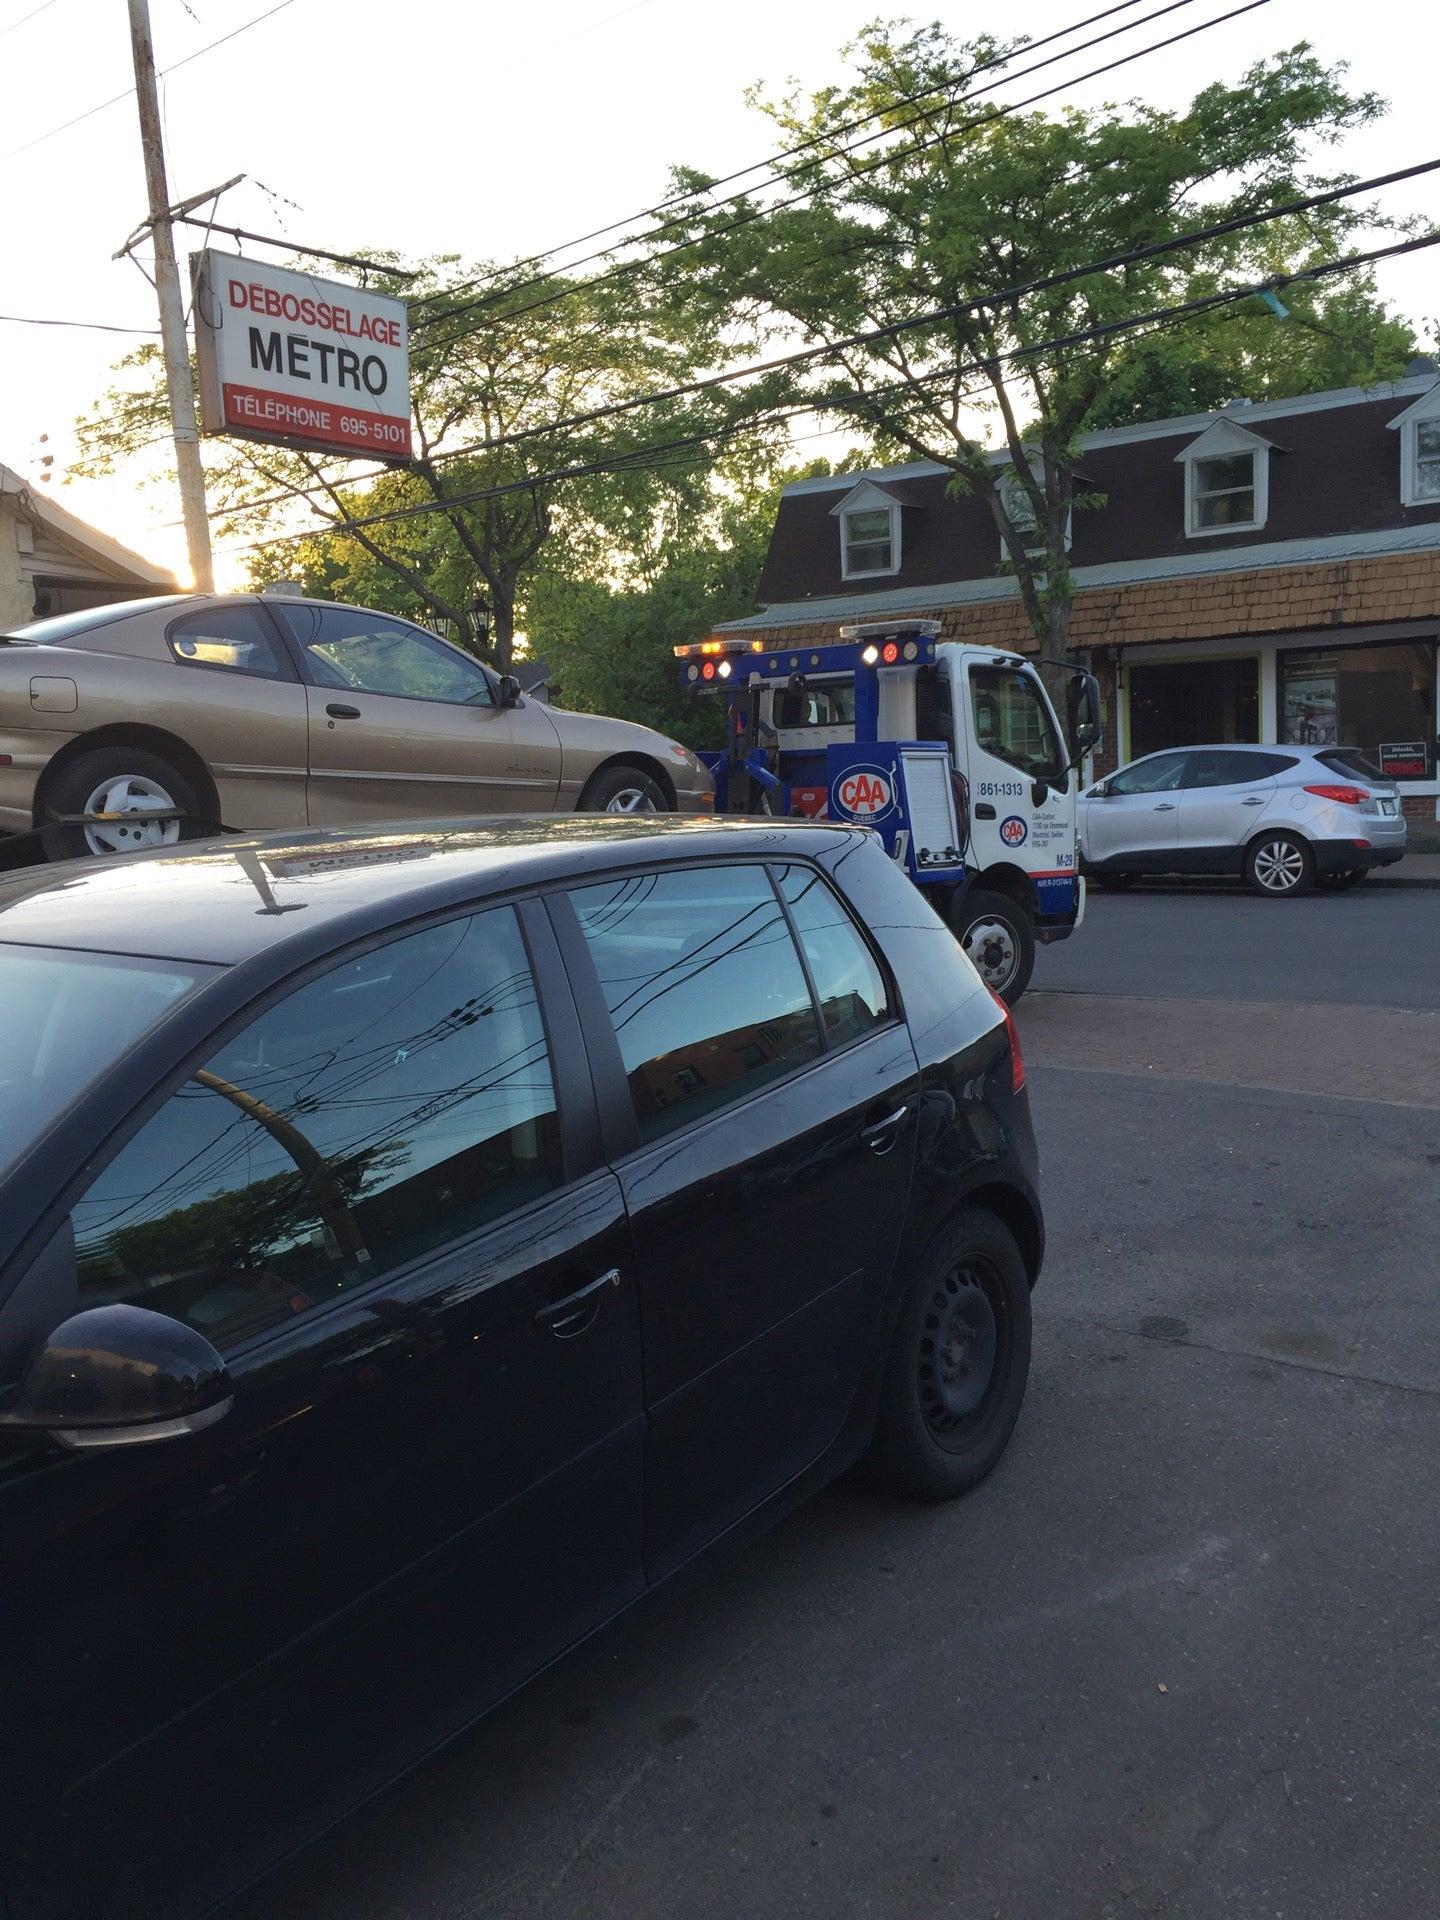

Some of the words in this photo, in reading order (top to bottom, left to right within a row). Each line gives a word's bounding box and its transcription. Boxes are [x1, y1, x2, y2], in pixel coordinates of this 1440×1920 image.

[228, 279, 401, 347] DÉBOSSELAGE
[232, 394, 331, 430] TÉLÉPHONE
[340, 416, 406, 444] 695-5101
[842, 775, 886, 812] CAA
[980, 782, 1023, 796] 861-1313
[1004, 821, 1023, 841] CAA
[1056, 854, 1073, 867] M-29
